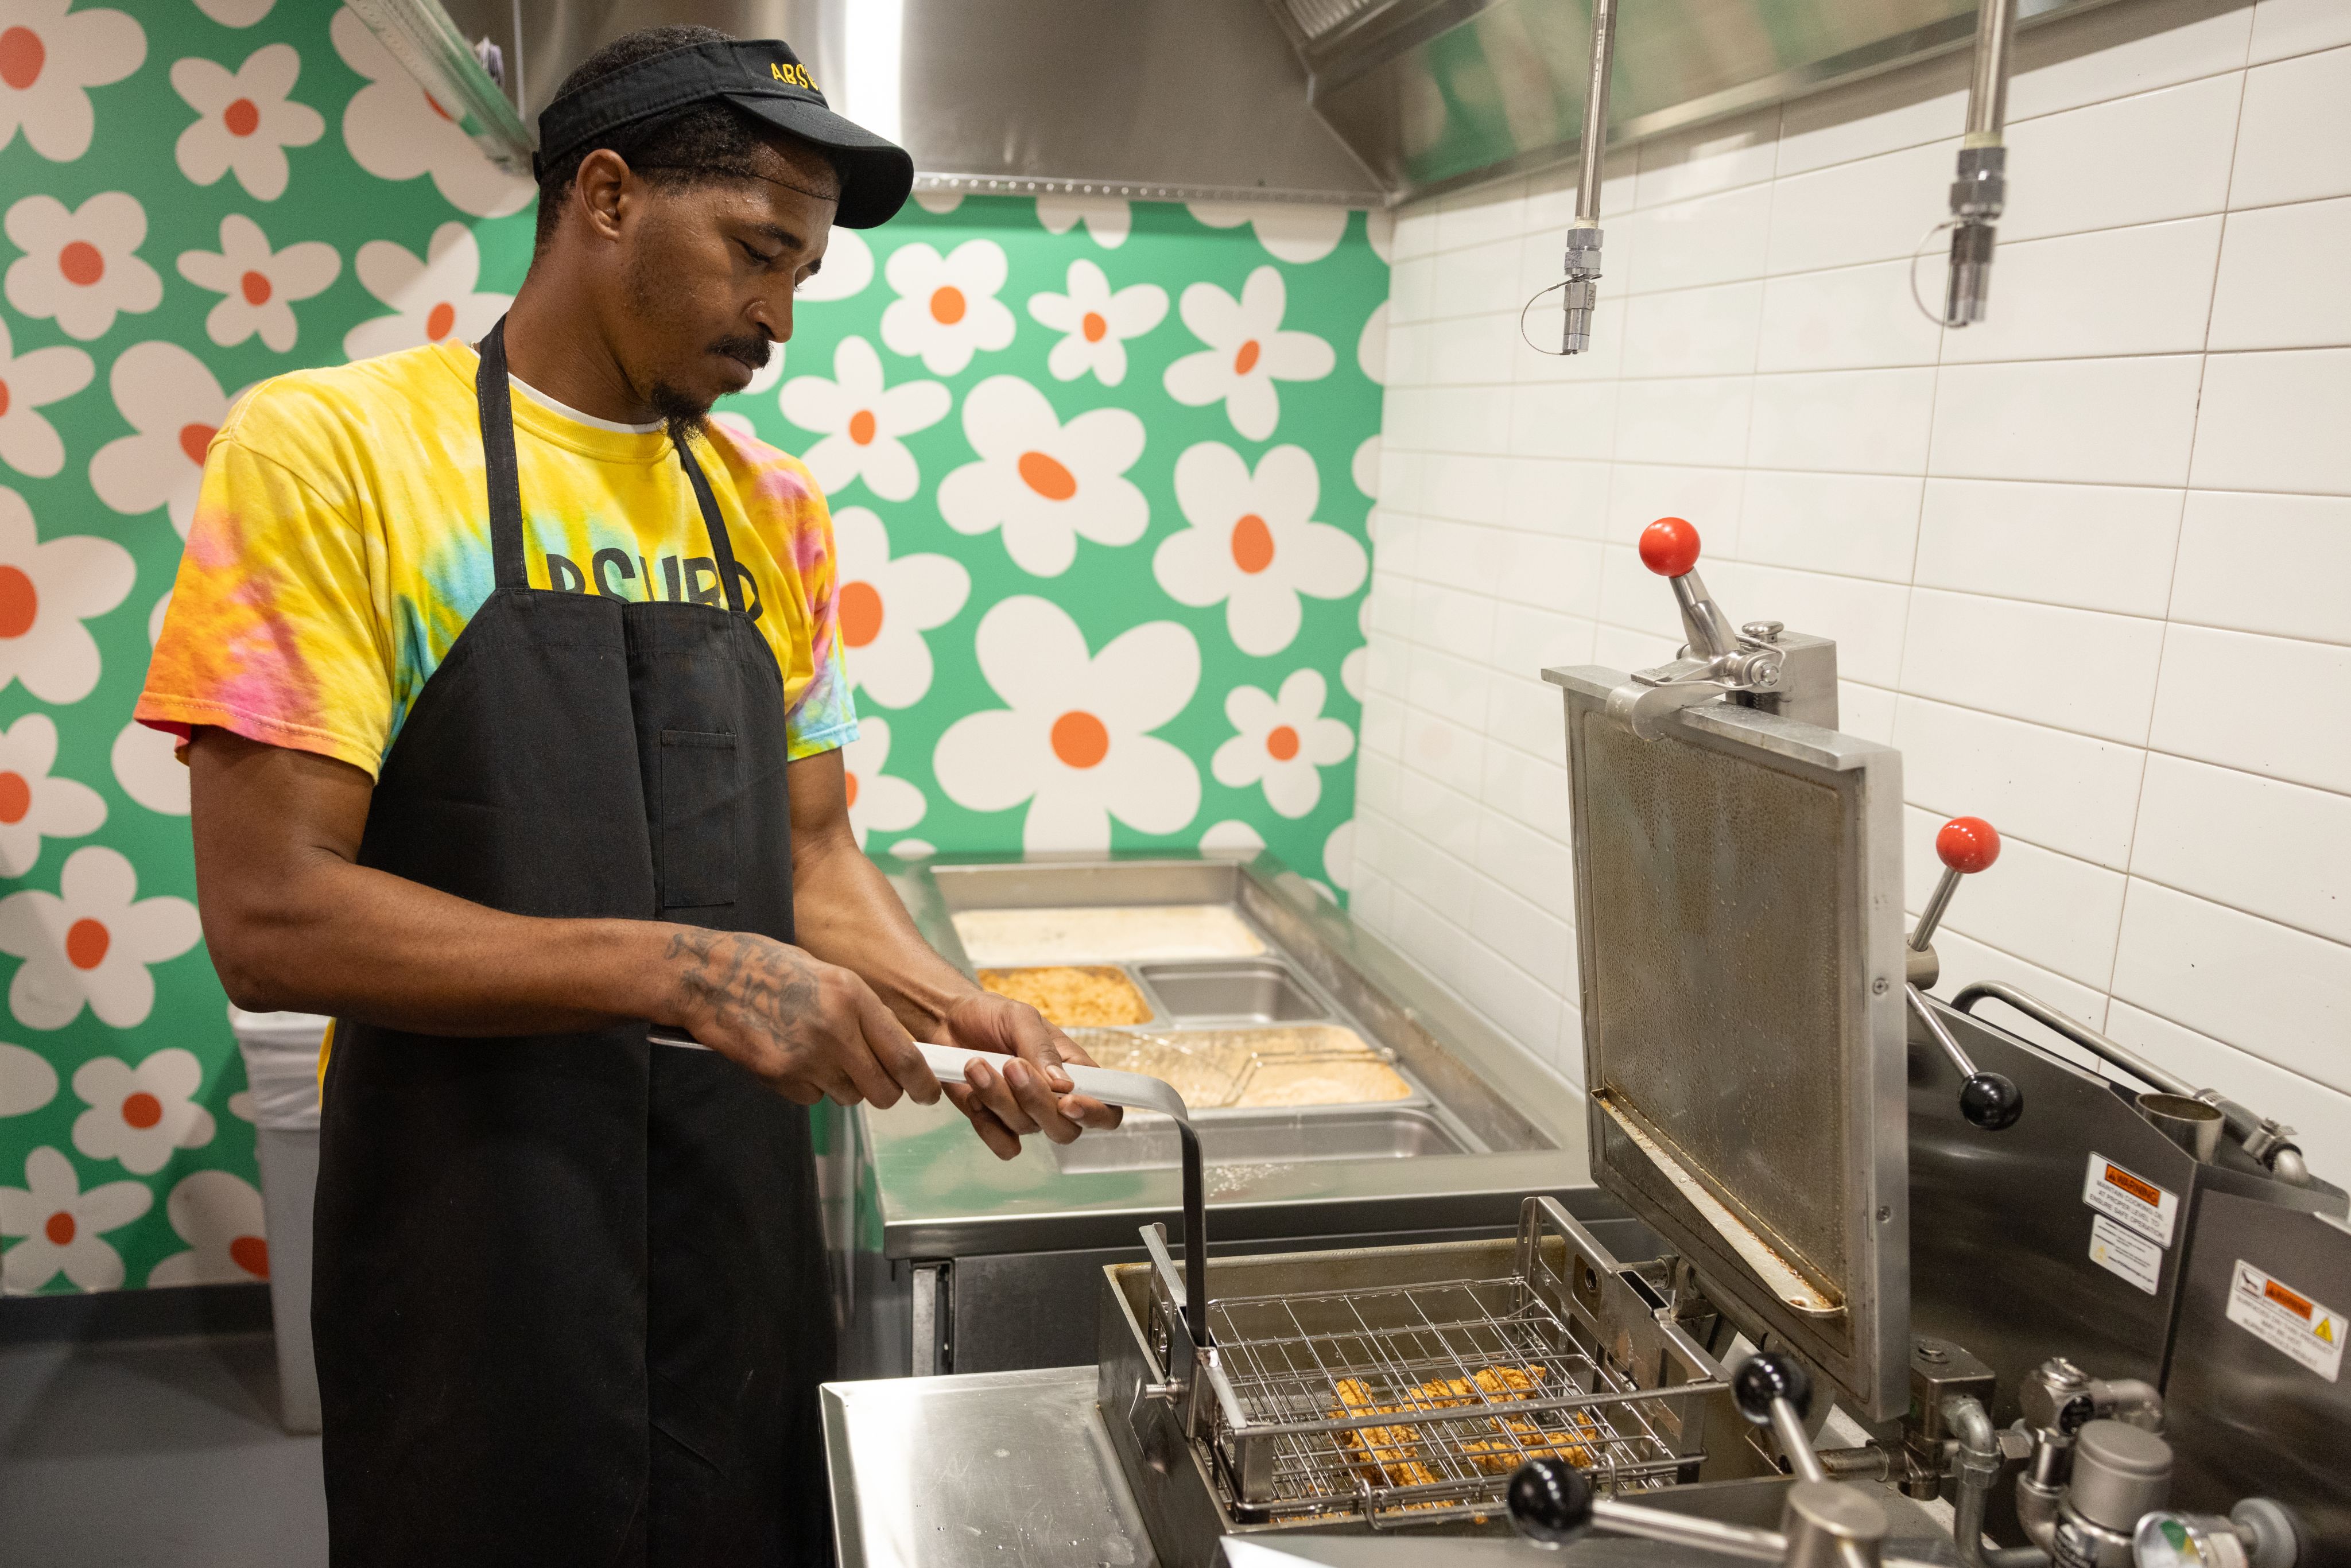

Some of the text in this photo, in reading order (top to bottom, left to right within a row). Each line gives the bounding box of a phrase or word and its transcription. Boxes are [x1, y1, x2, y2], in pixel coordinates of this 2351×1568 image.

[2096, 1179, 2123, 1198] MAINTAIN
[2125, 1195, 2152, 1214] COOKING
[2106, 1194, 2130, 1211] PROPER
[2131, 1208, 2149, 1221] LEVEL
[2151, 1218, 2159, 1227] TO
[2089, 1193, 2112, 1210] ENSURE
[2114, 1207, 2128, 1219] SAFE
[2130, 1216, 2164, 1239] OPERATION
